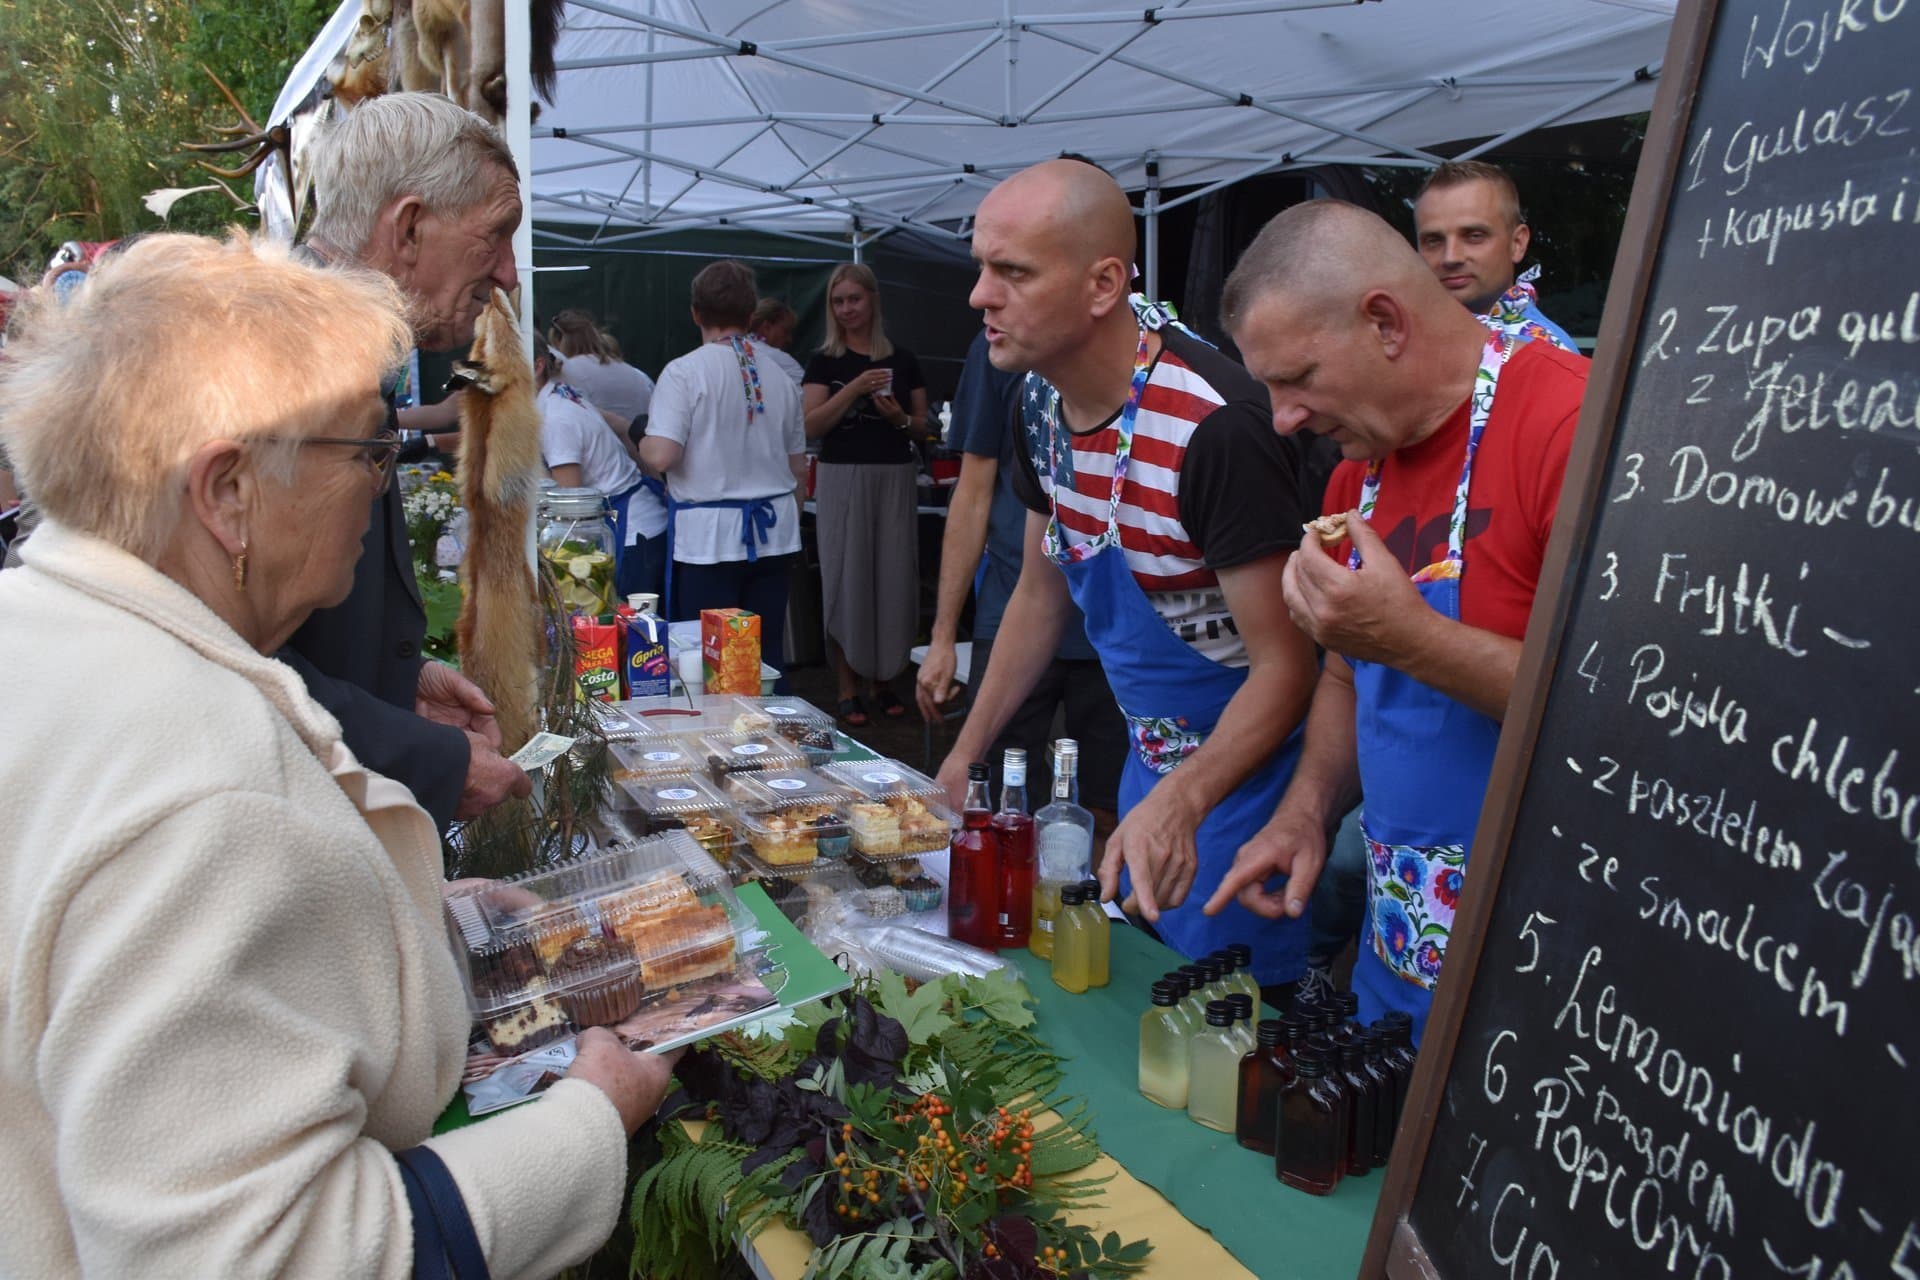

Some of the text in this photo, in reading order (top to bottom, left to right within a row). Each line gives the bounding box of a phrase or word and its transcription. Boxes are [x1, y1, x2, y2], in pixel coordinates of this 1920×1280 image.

[1696, 304, 1822, 368] Zupa
[1653, 552, 1809, 658] Frytki
[579, 671, 616, 686] Costa
[631, 644, 665, 669] Caprio
